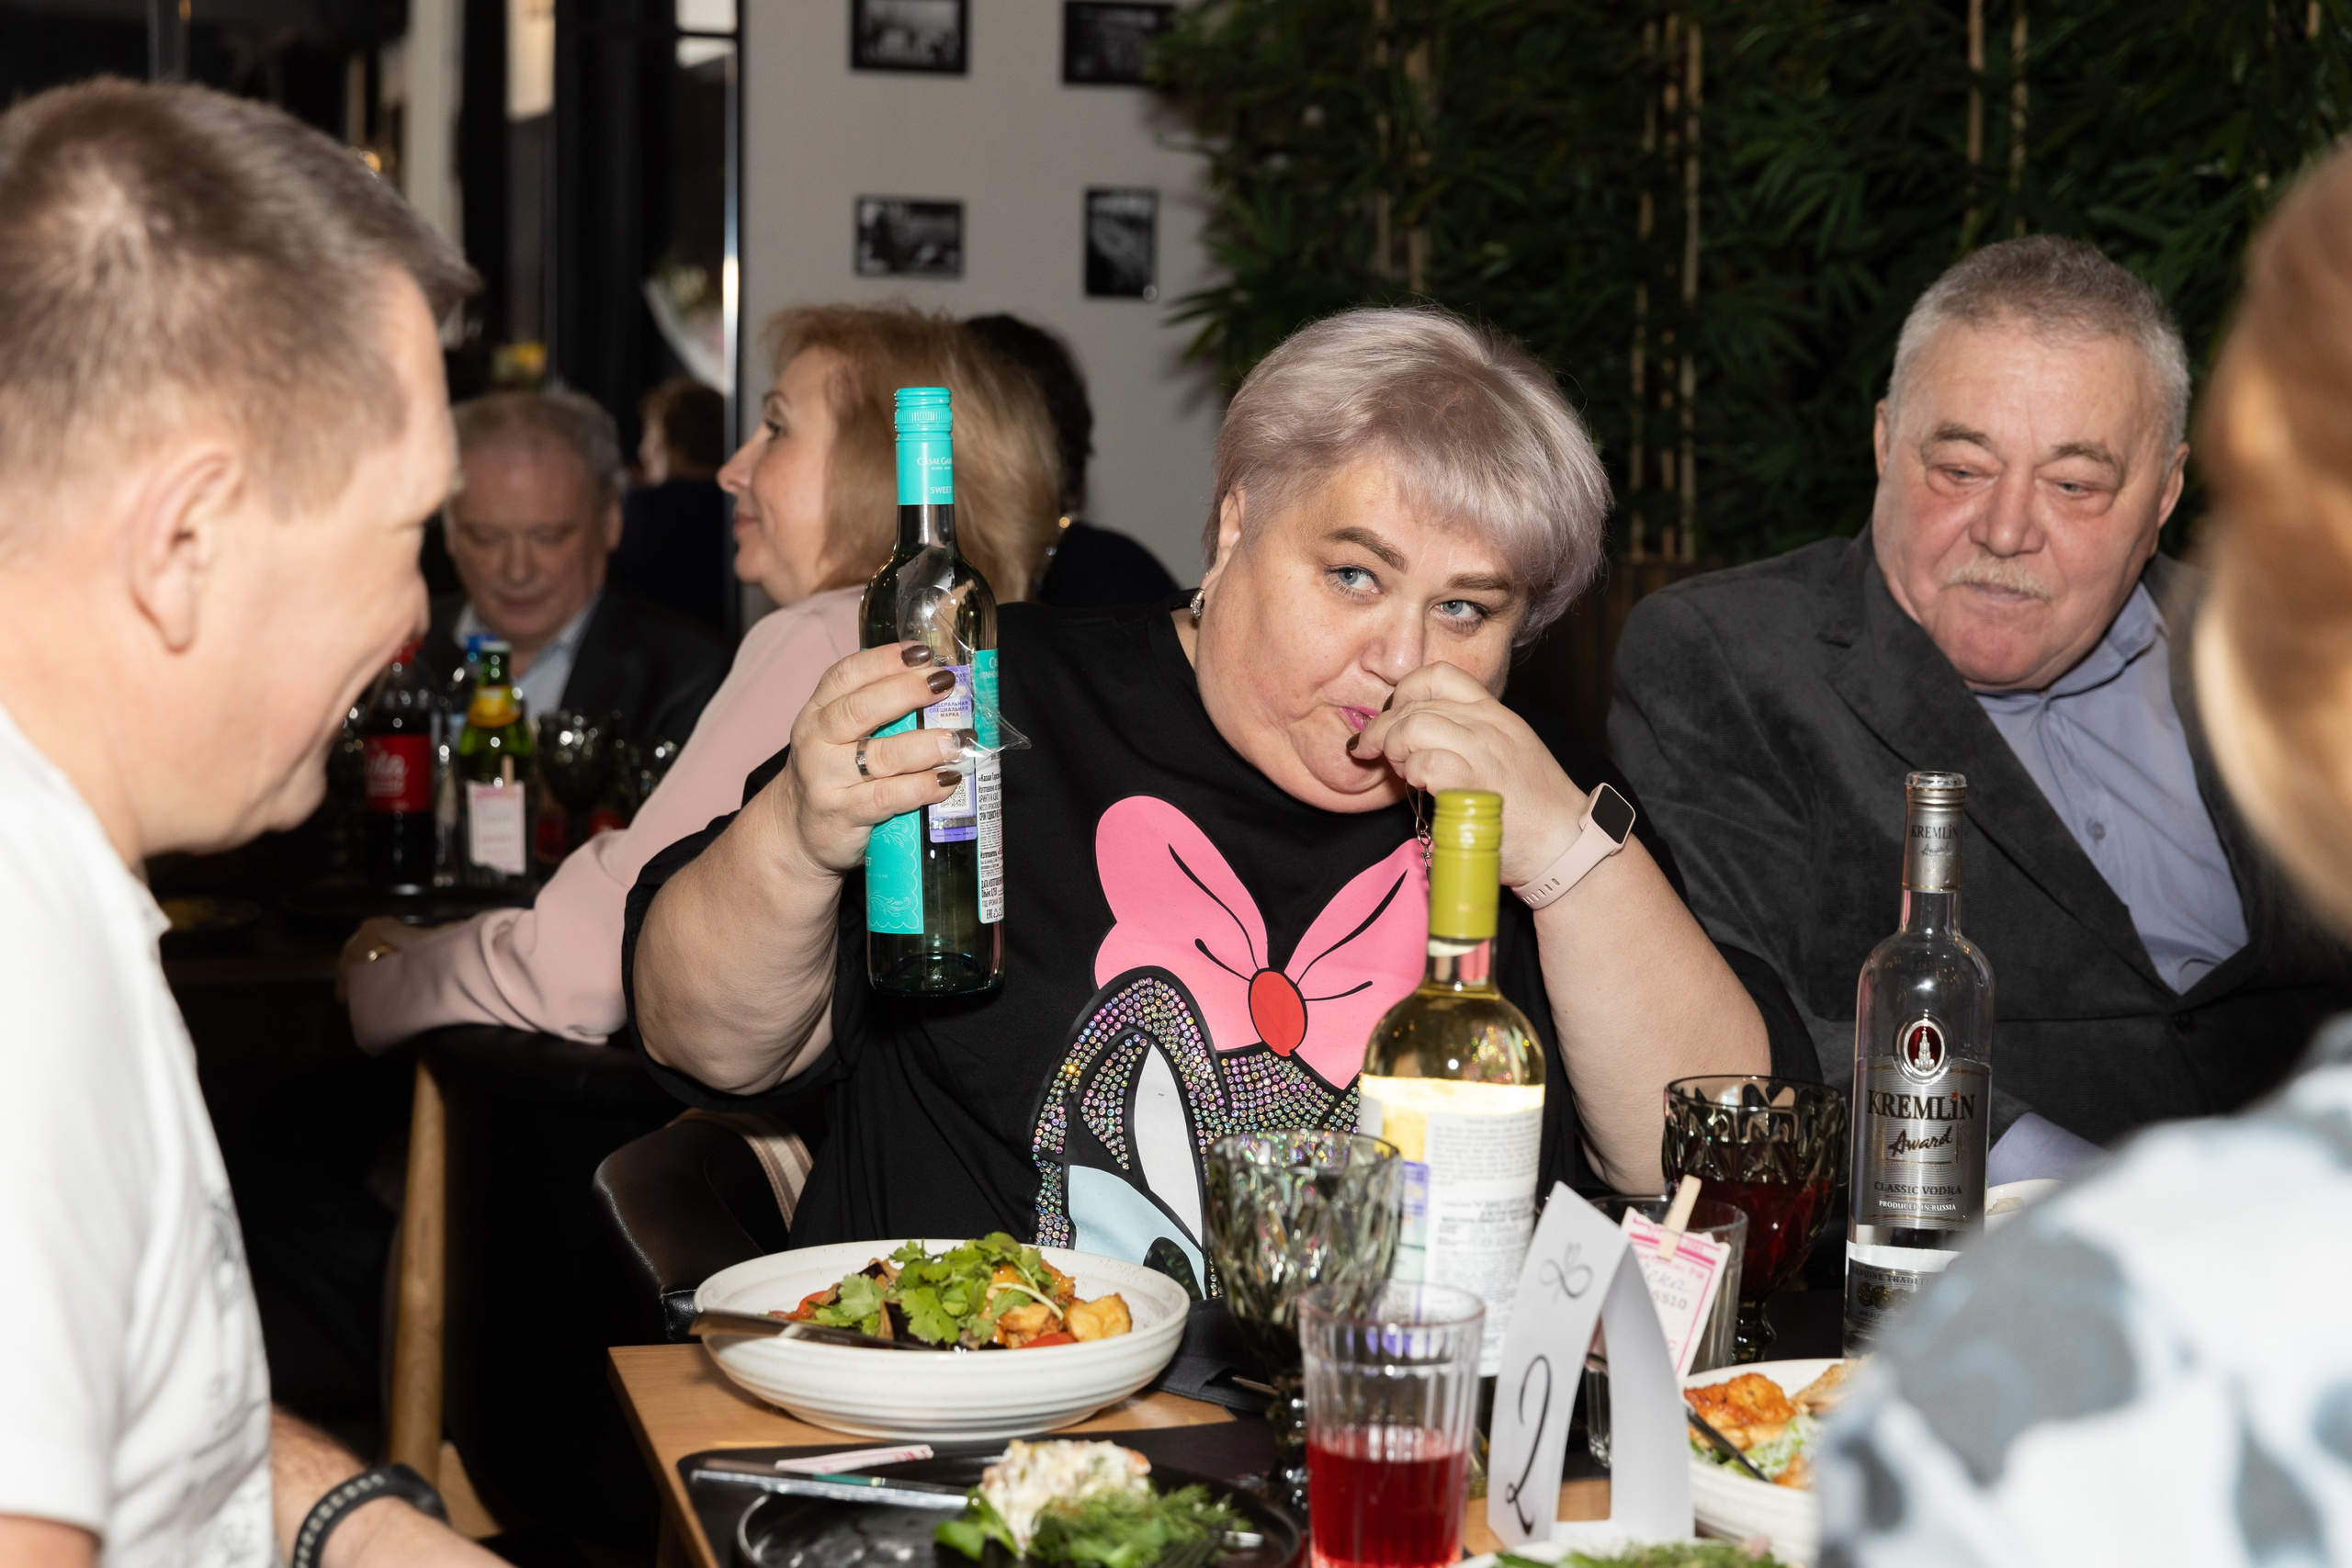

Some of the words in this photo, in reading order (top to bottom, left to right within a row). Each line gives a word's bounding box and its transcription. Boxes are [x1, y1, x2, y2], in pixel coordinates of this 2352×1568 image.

[1888, 1125, 1952, 1157] Award
[1874, 1181, 1918, 1194] CLASSIC
[1922, 1185, 1962, 1195] VODKA
